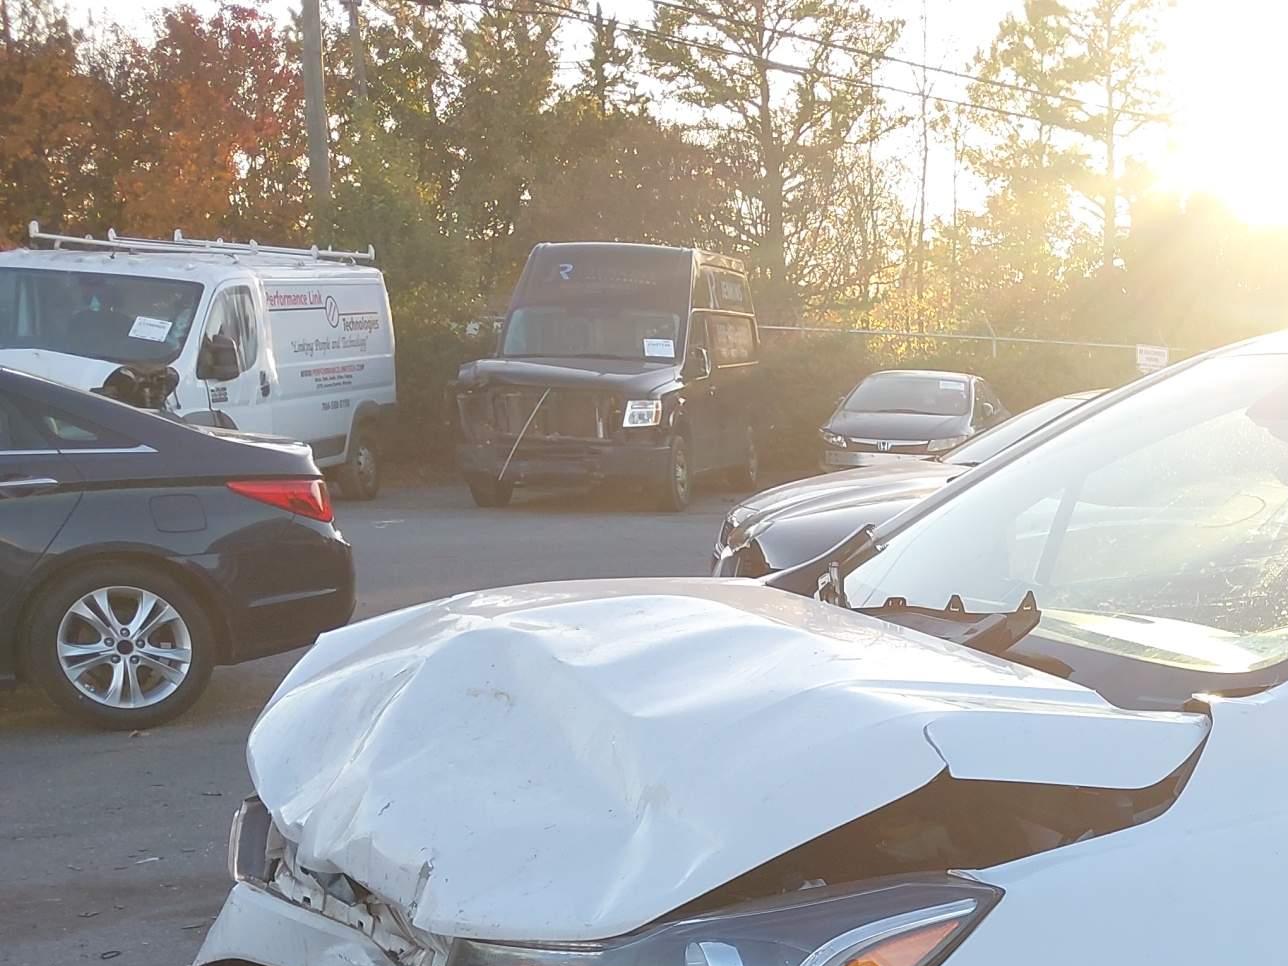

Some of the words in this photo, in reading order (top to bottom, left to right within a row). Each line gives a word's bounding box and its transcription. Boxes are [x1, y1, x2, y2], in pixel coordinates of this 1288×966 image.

[265, 290, 308, 306] Performance
[309, 289, 322, 305] Link
[342, 317, 380, 333] Technologies
